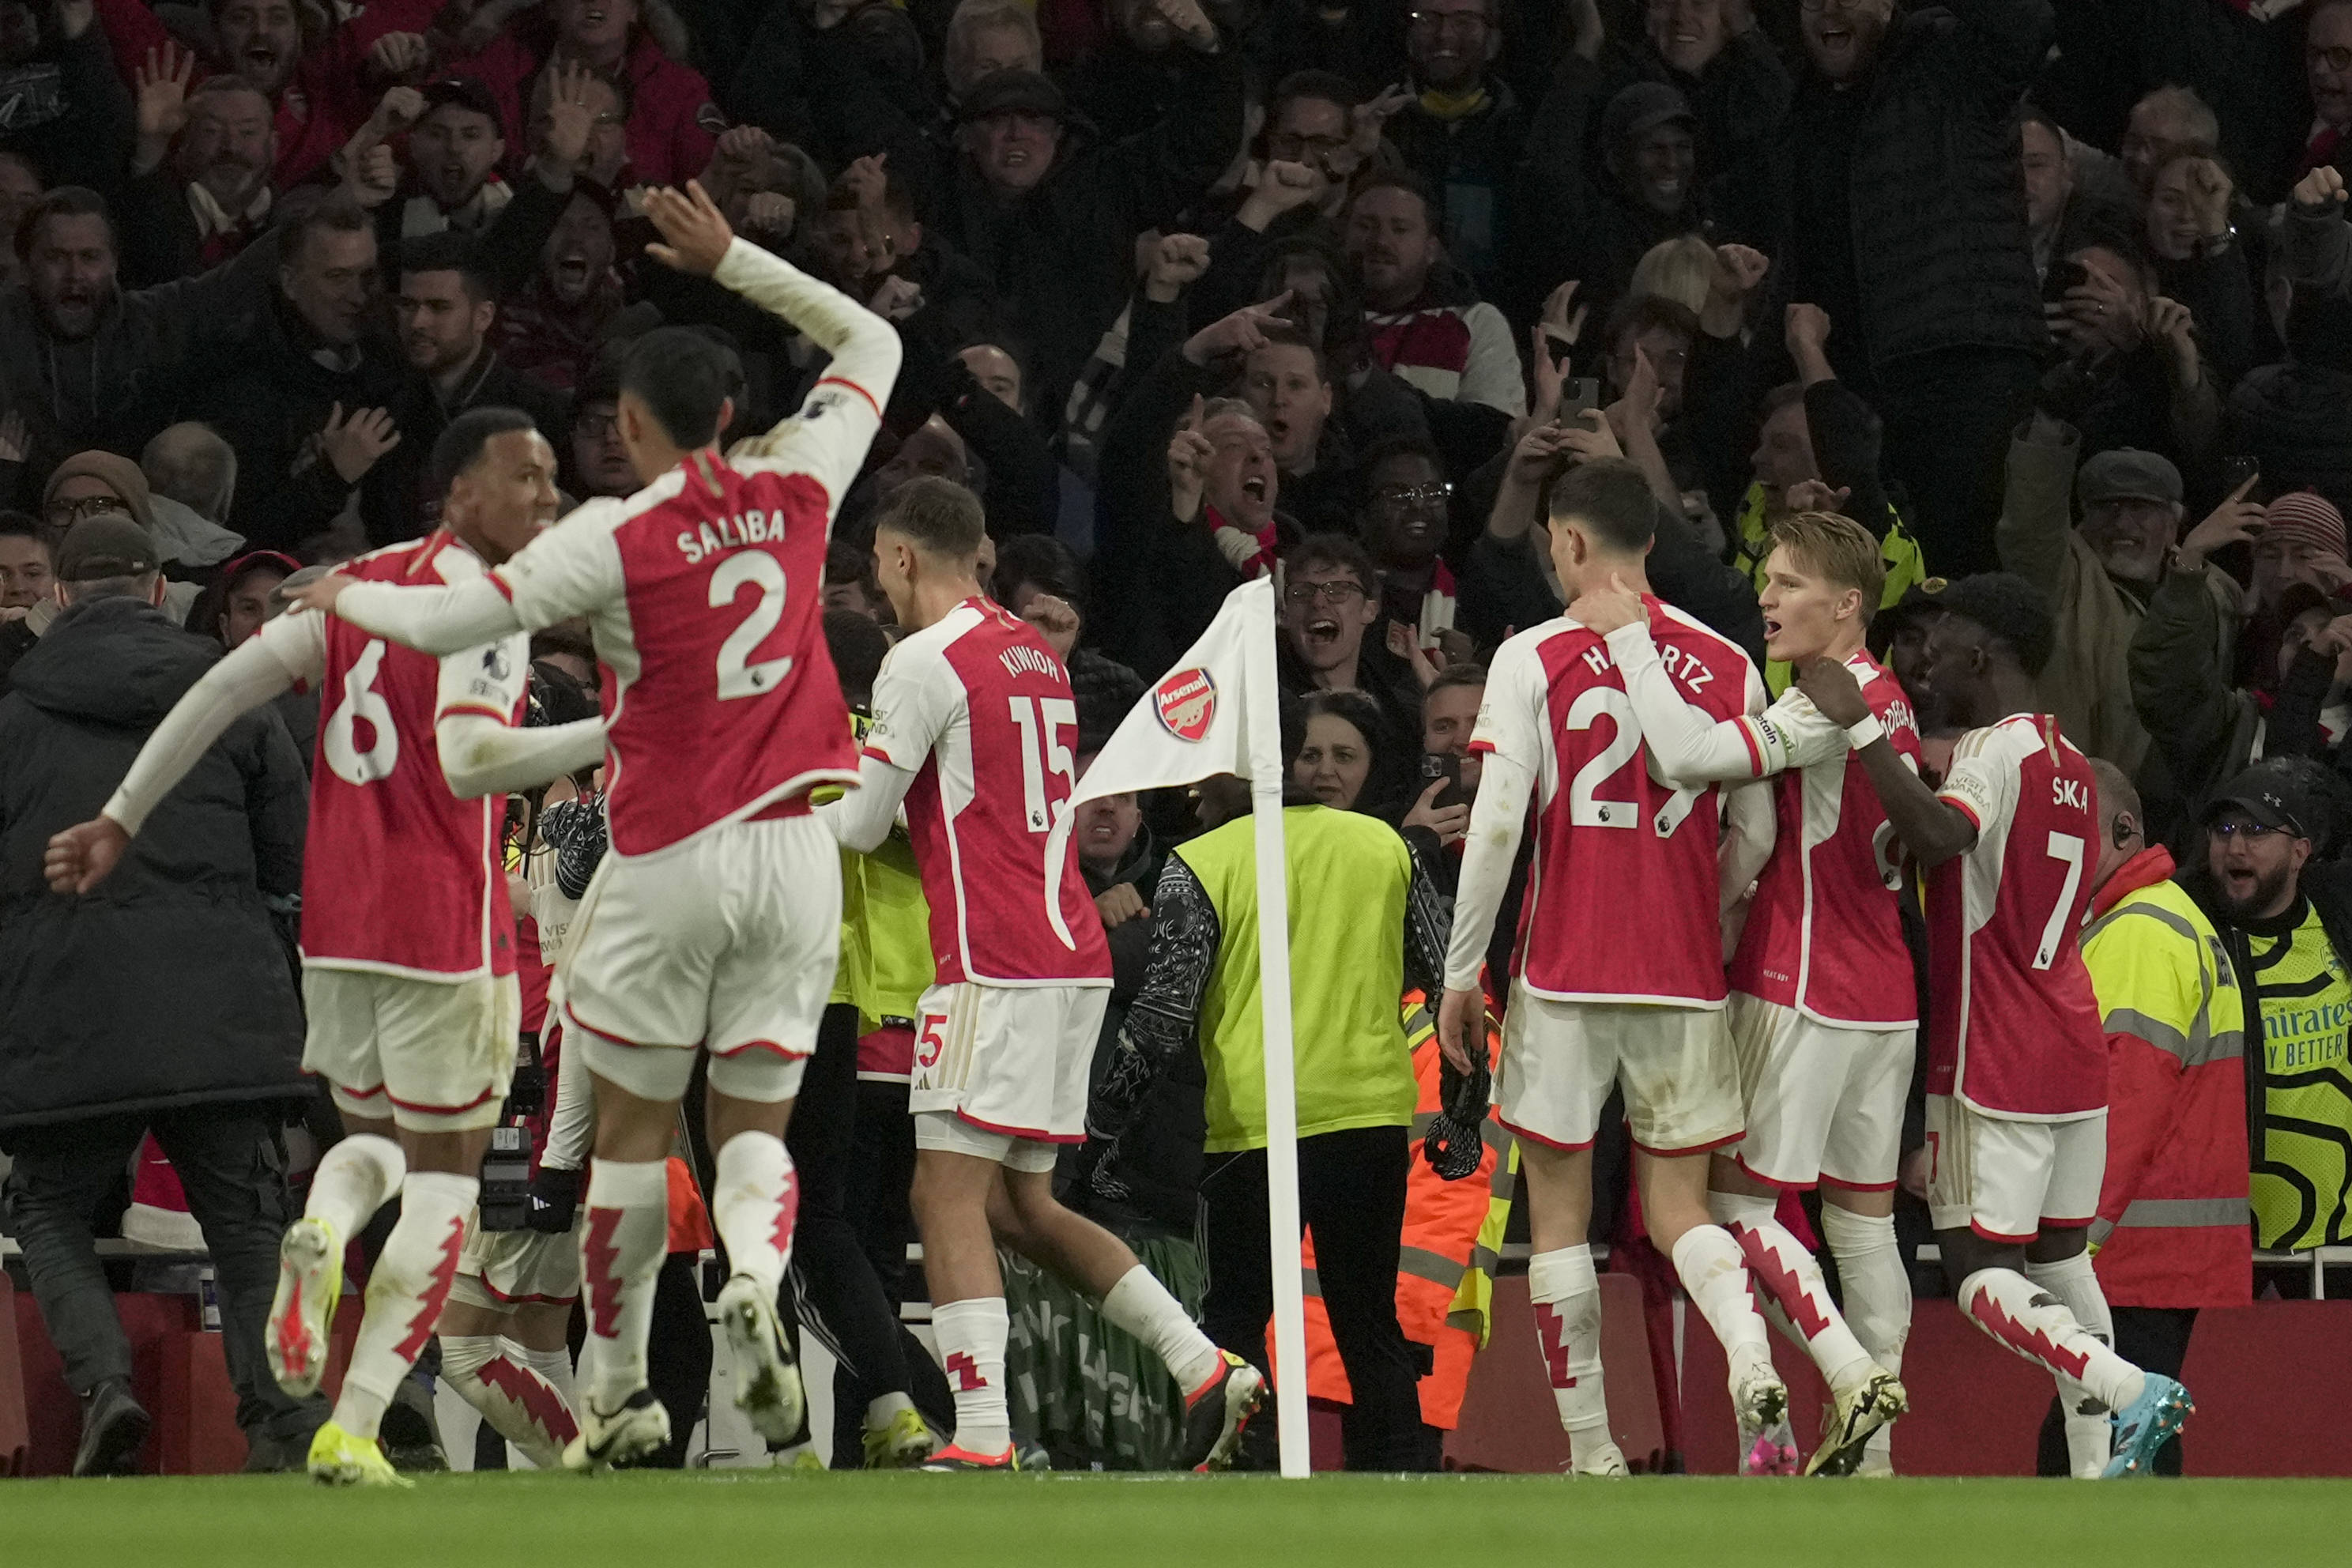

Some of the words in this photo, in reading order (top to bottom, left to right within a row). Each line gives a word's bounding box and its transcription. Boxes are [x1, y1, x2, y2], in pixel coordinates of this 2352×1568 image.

[677, 509, 786, 565] SALIBA
[707, 548, 793, 703] 2
[998, 645, 1061, 684] KIWIOR
[1159, 674, 1206, 708] Arsenal
[1581, 640, 1714, 695] HRTZ
[322, 638, 399, 787] 6
[1008, 695, 1077, 838] 15
[2031, 830, 2085, 971] 7
[2286, 1033, 2343, 1068] BETTER
